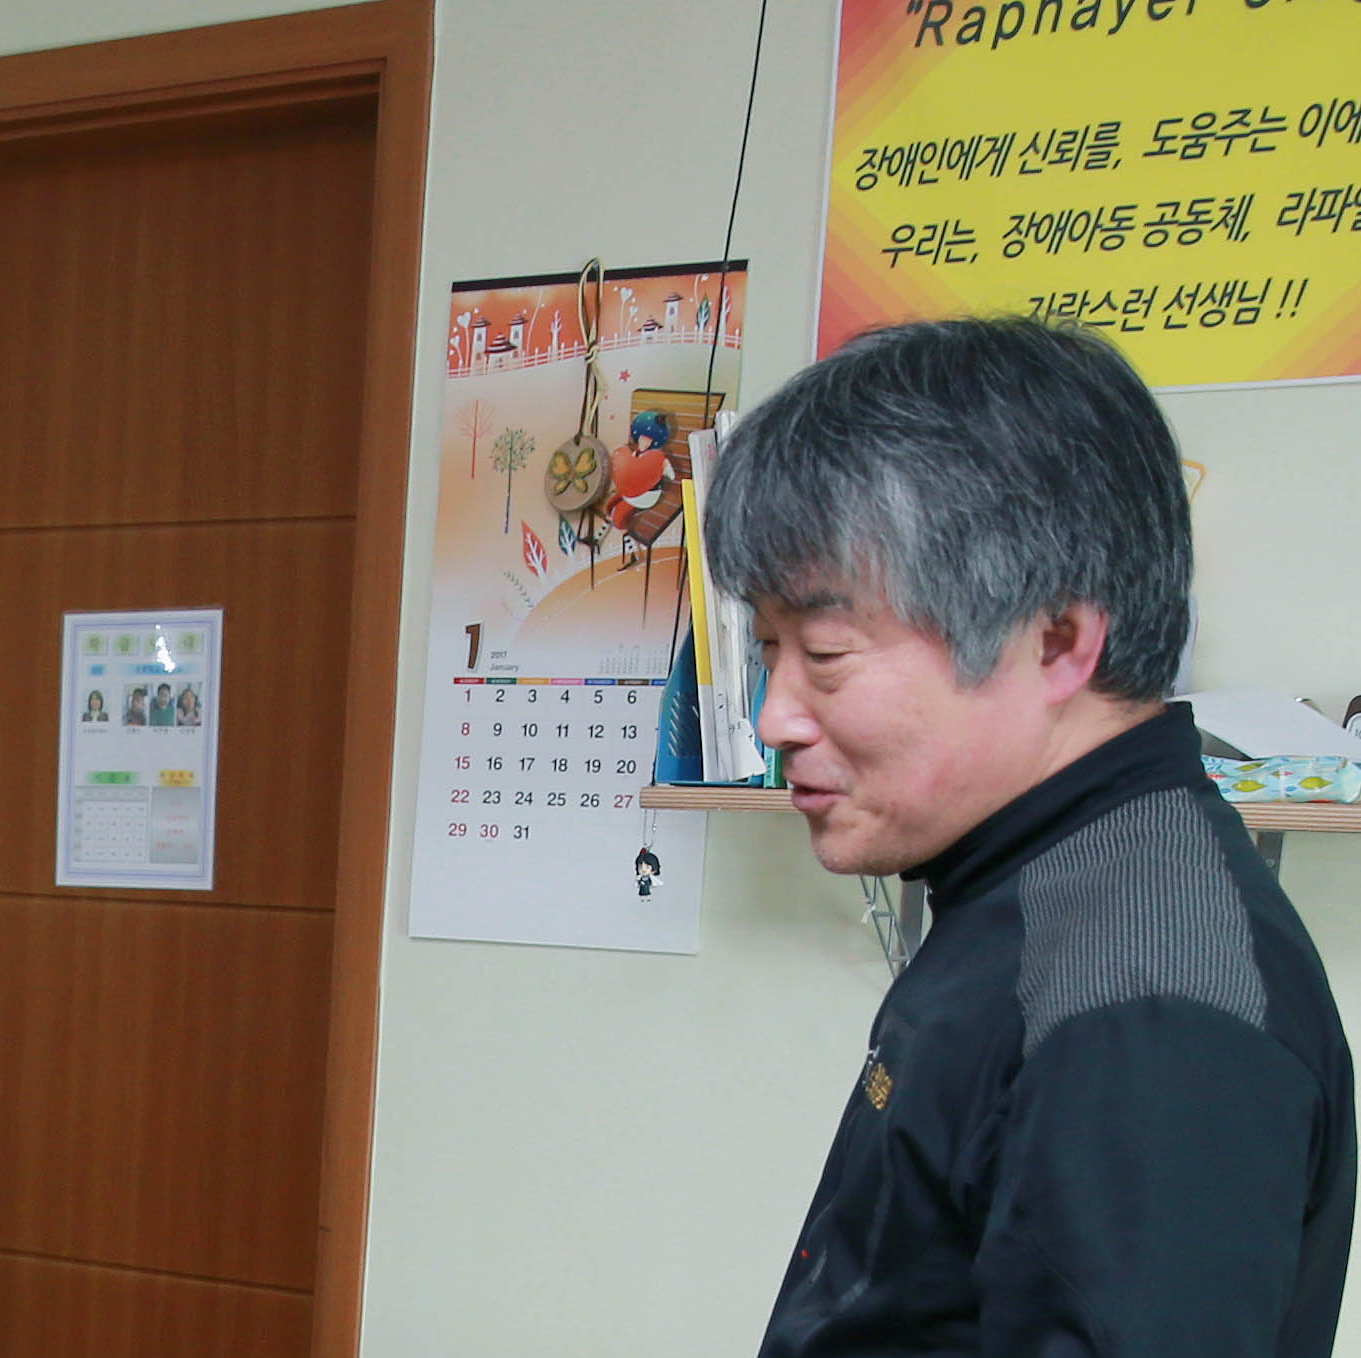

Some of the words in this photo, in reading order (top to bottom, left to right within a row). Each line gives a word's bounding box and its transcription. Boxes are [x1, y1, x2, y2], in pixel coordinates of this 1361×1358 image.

[855, 131, 1017, 191] 장애인에게
[1018, 120, 1122, 175] 신뢰를,
[1143, 106, 1288, 161] 도움주는
[881, 219, 979, 268] 우리는,
[1002, 204, 1140, 259] 장애아동
[1143, 193, 1256, 247] 공동체,
[1163, 276, 1272, 330] 선생님
[1275, 277, 1309, 319] !!
[464, 623, 482, 670] 1
[465, 689, 471, 702] 1
[495, 688, 505, 703] 2
[527, 688, 537, 703] 3
[560, 689, 570, 703] 4
[593, 689, 603, 704] 5
[627, 690, 637, 705] 6
[461, 722, 470, 736] 8
[493, 722, 502, 737] 9
[522, 723, 538, 737] 10
[556, 724, 569, 737] 11
[588, 724, 604, 738] 12
[621, 725, 637, 739] 13
[455, 756, 470, 770] 15
[487, 757, 502, 770] 16
[520, 757, 535, 770] 17
[553, 758, 568, 772] 18
[585, 759, 601, 773] 19
[616, 759, 637, 774] 20
[451, 789, 470, 803] 22
[482, 790, 501, 805] 23
[515, 791, 533, 805] 24
[547, 792, 566, 807] 25
[580, 793, 600, 808] 26
[613, 794, 634, 809] 27
[448, 822, 467, 837] 29
[480, 823, 499, 838] 30
[513, 825, 529, 839] 31
